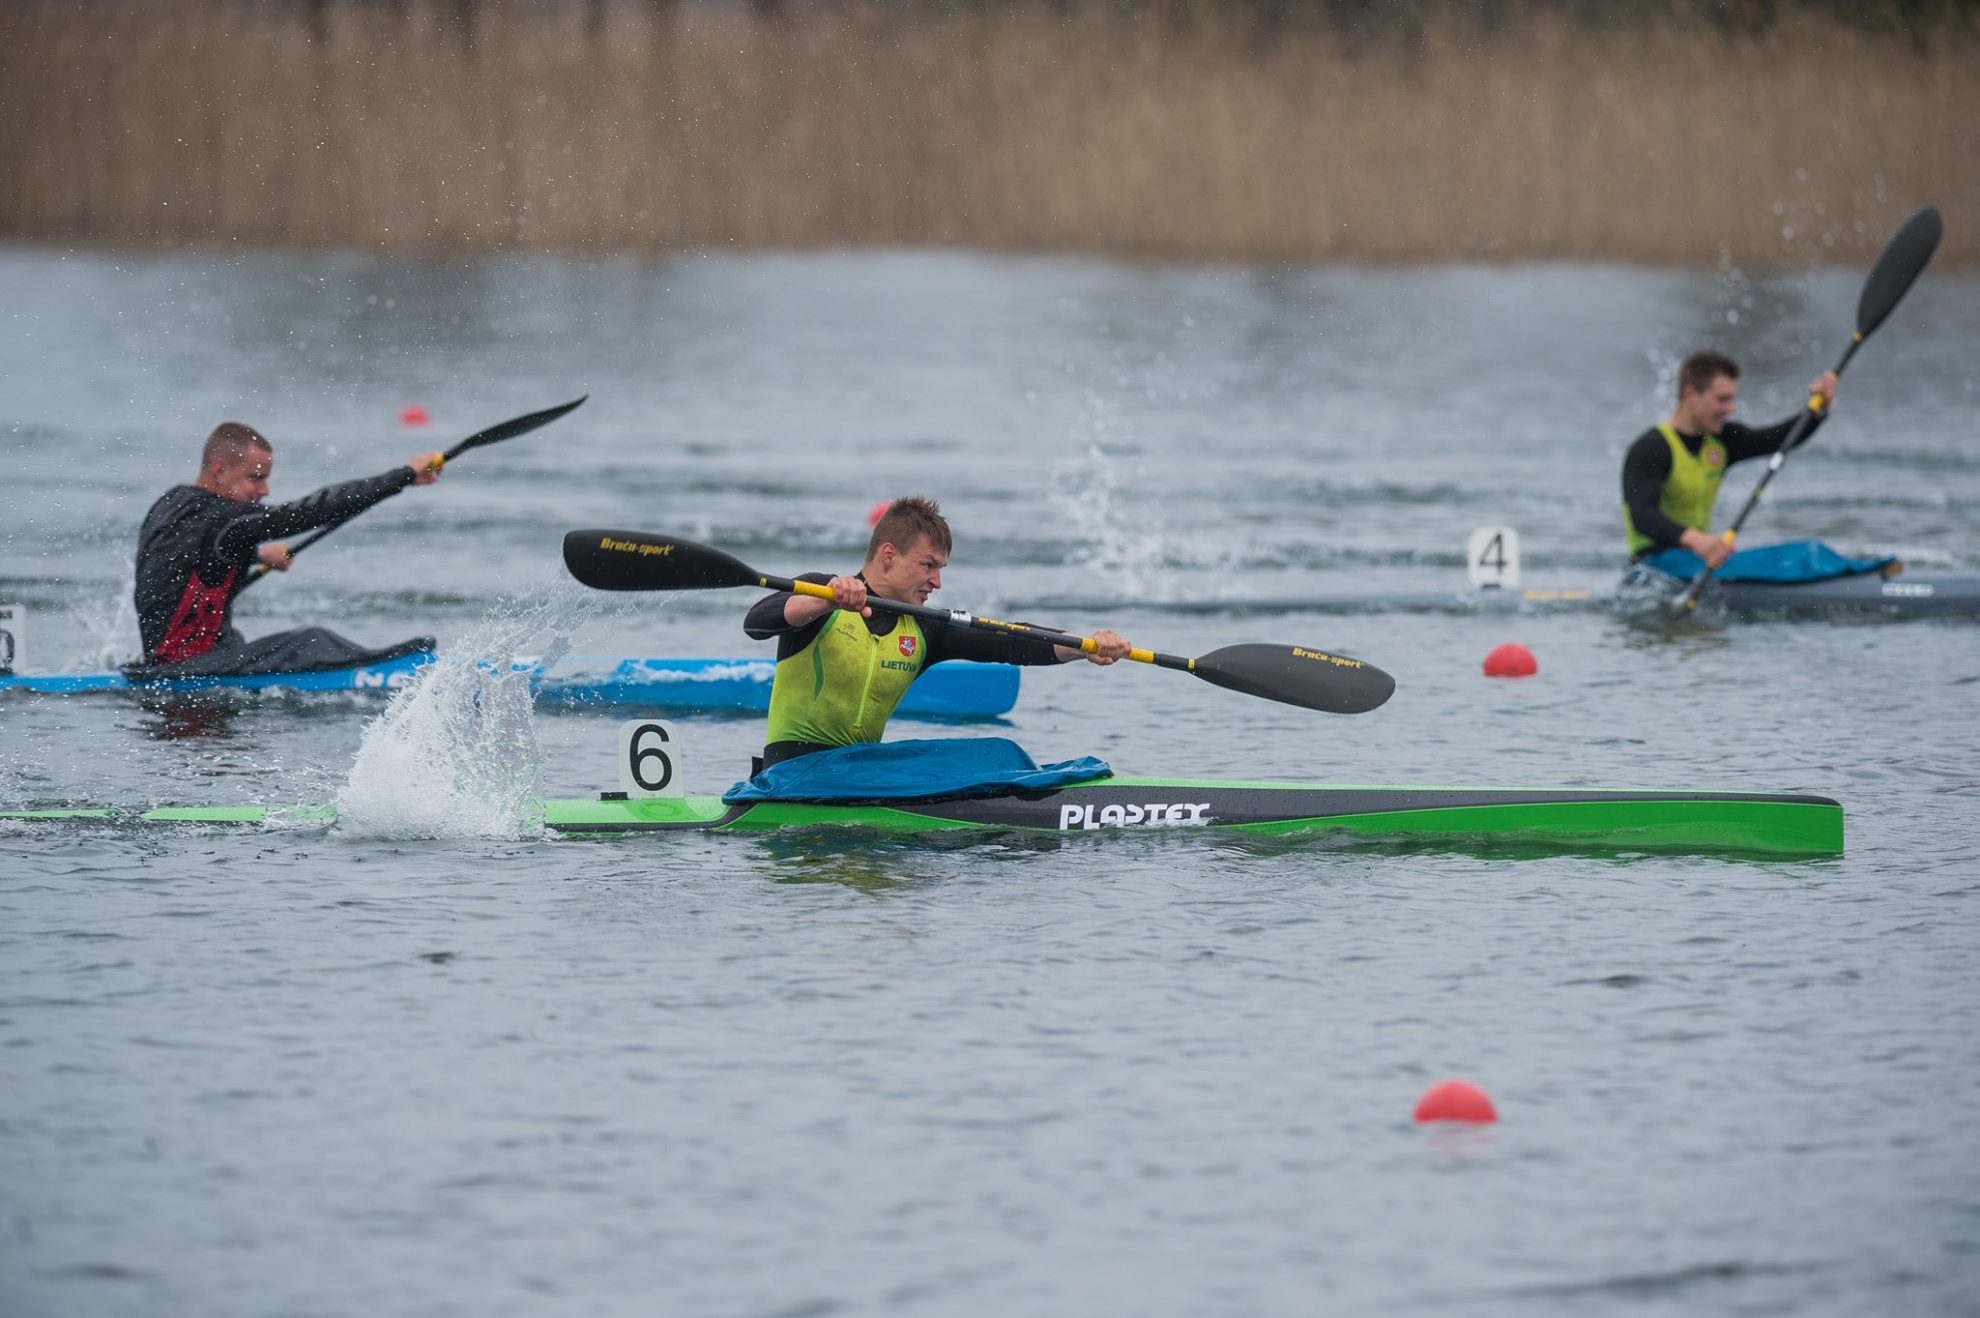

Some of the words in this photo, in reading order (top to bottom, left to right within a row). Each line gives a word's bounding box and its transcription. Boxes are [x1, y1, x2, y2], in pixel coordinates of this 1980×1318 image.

[1479, 533, 1508, 573] 4
[629, 723, 673, 791] 6
[1059, 803, 1211, 830] PLASTEX
